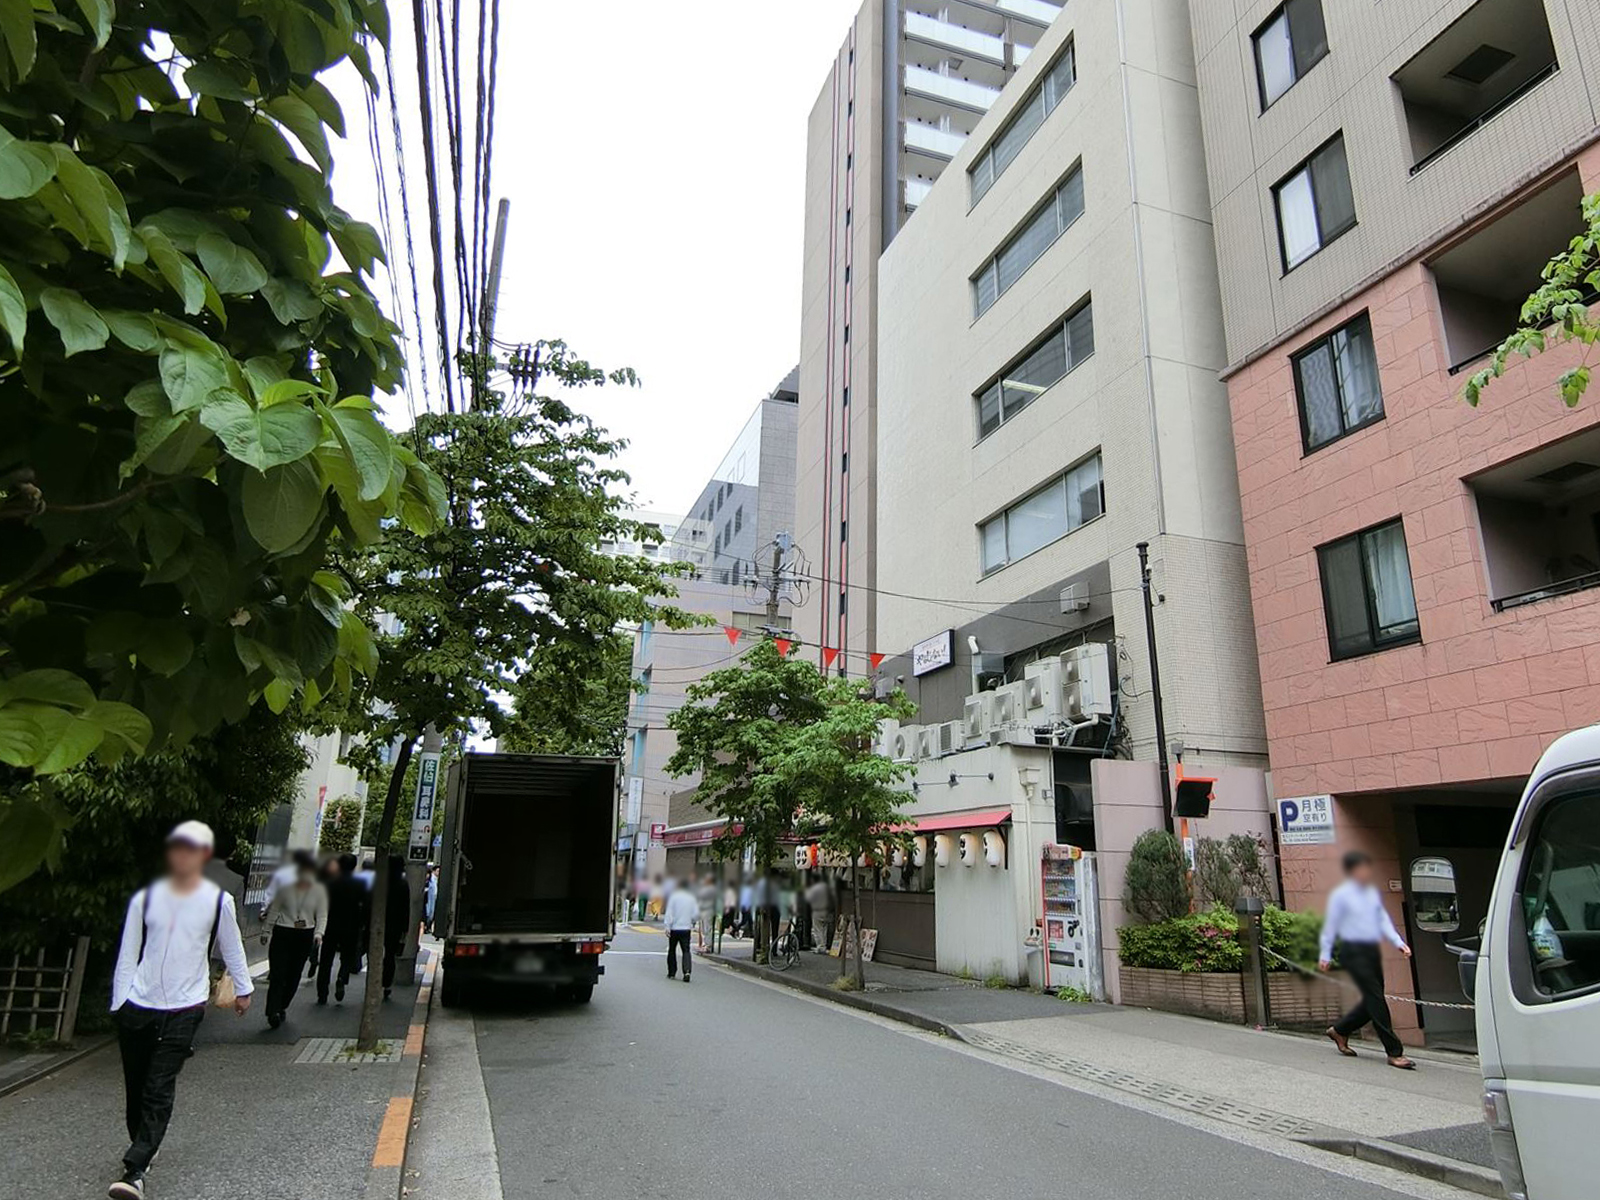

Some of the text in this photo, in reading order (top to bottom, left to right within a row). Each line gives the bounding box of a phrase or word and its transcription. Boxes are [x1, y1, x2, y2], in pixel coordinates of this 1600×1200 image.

[1302, 798, 1326, 812] 月極
[1281, 801, 1299, 832] P
[1303, 813, 1327, 823] 空有り
